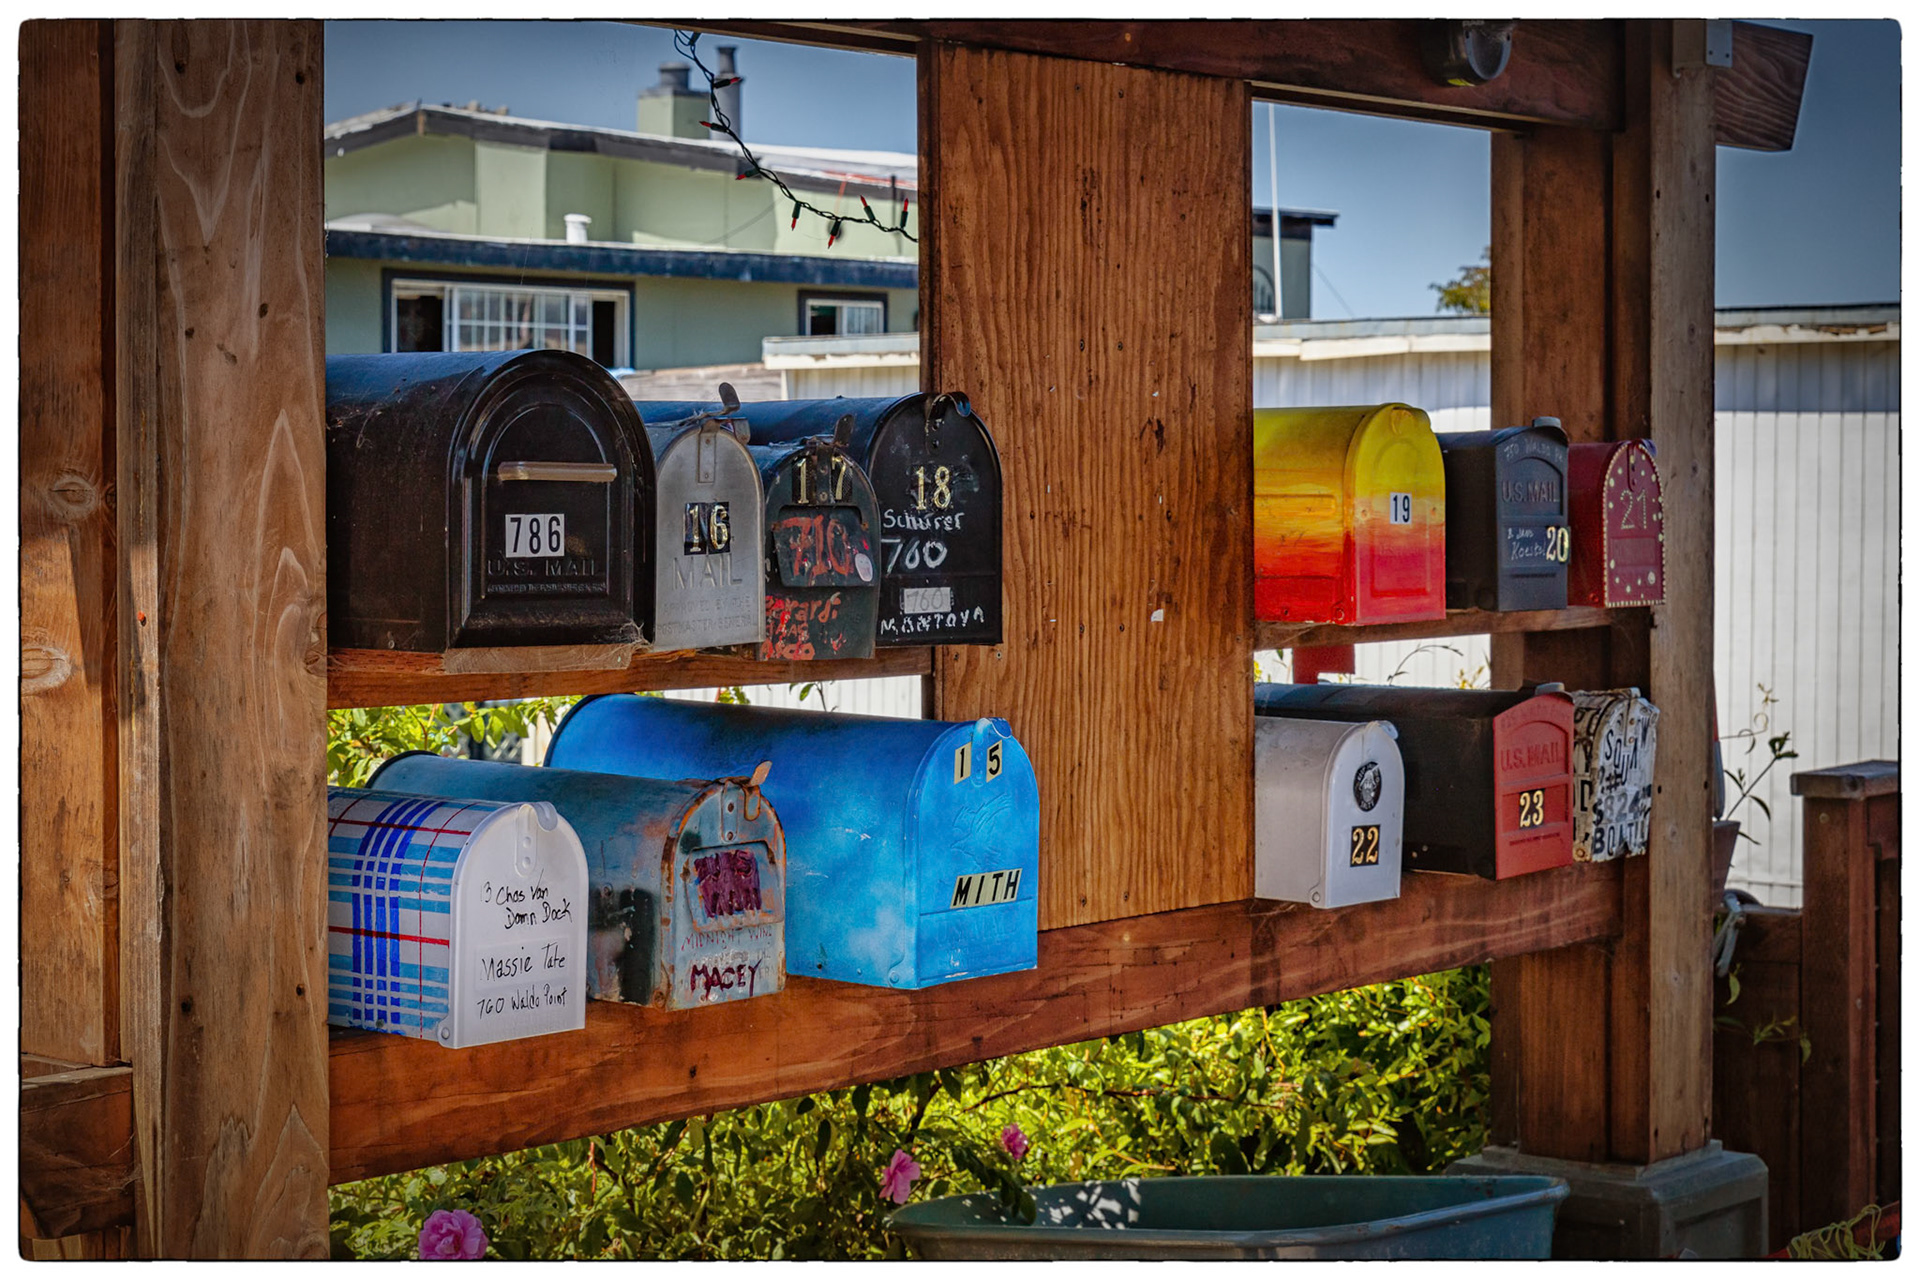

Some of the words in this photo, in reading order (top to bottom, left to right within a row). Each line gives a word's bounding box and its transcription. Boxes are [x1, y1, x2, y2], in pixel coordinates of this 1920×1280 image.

[796, 455, 848, 504] 17
[915, 465, 952, 511] 18
[1502, 480, 1525, 502] U.S.
[1527, 480, 1560, 502] MAIL
[1393, 494, 1411, 523] 19
[1620, 489, 1647, 530] 21
[510, 516, 560, 554] 786
[689, 504, 729, 553] 16
[1546, 526, 1569, 562] 20
[545, 559, 601, 576] MAIL
[673, 553, 743, 590] MAIL
[880, 537, 948, 578] 760
[906, 586, 944, 613] 760
[1500, 747, 1525, 772] U.S.
[1527, 741, 1562, 768] MAIL
[1520, 790, 1544, 828] 23
[1351, 826, 1379, 864] 22
[953, 869, 1020, 907] MITH
[542, 897, 573, 924] Dock
[541, 942, 566, 969] Tate
[690, 957, 763, 998] MACEY
[477, 997, 505, 1020] 760
[511, 984, 540, 1010] Waldo
[544, 983, 568, 1007] Point
